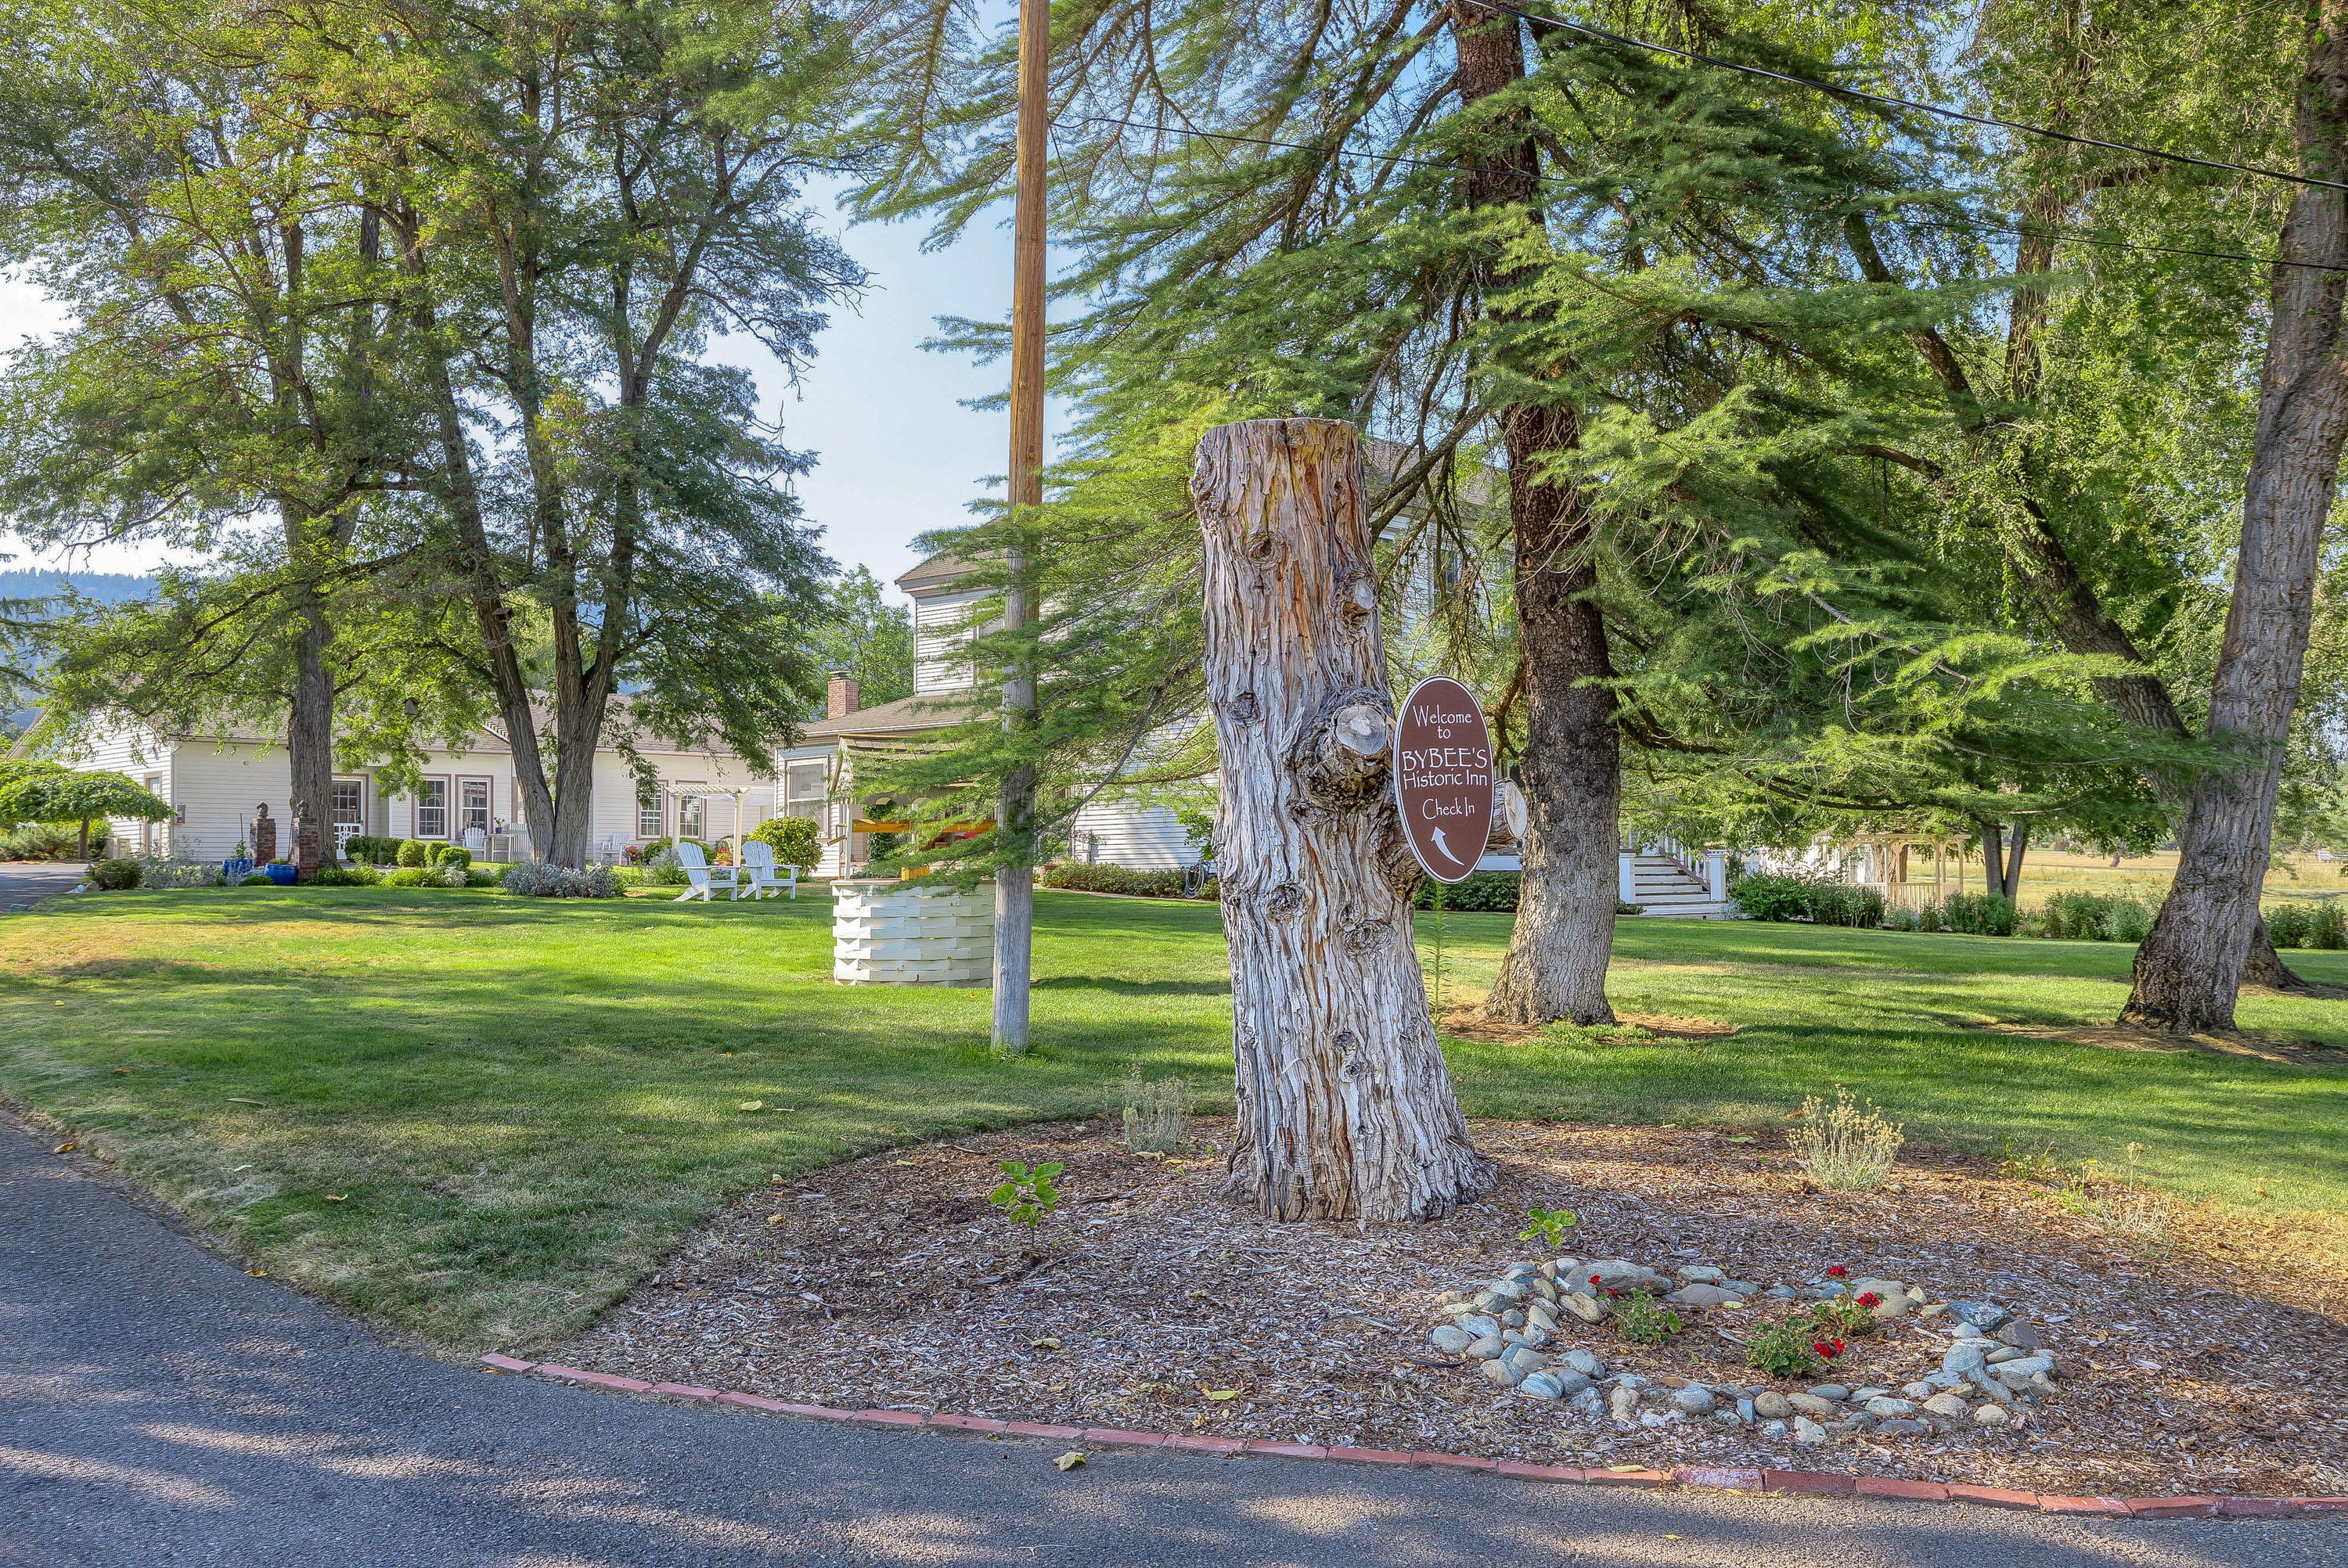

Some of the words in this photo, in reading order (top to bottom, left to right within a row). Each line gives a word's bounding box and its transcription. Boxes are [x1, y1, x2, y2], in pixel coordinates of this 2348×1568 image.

[1413, 704, 1471, 728] Welcome
[1438, 725, 1451, 739] to
[1402, 747, 1487, 771] BYBEE'S
[1403, 768, 1463, 789] Historic
[1466, 769, 1487, 786] Inn
[1422, 797, 1463, 820] Check
[1464, 797, 1475, 817] In
